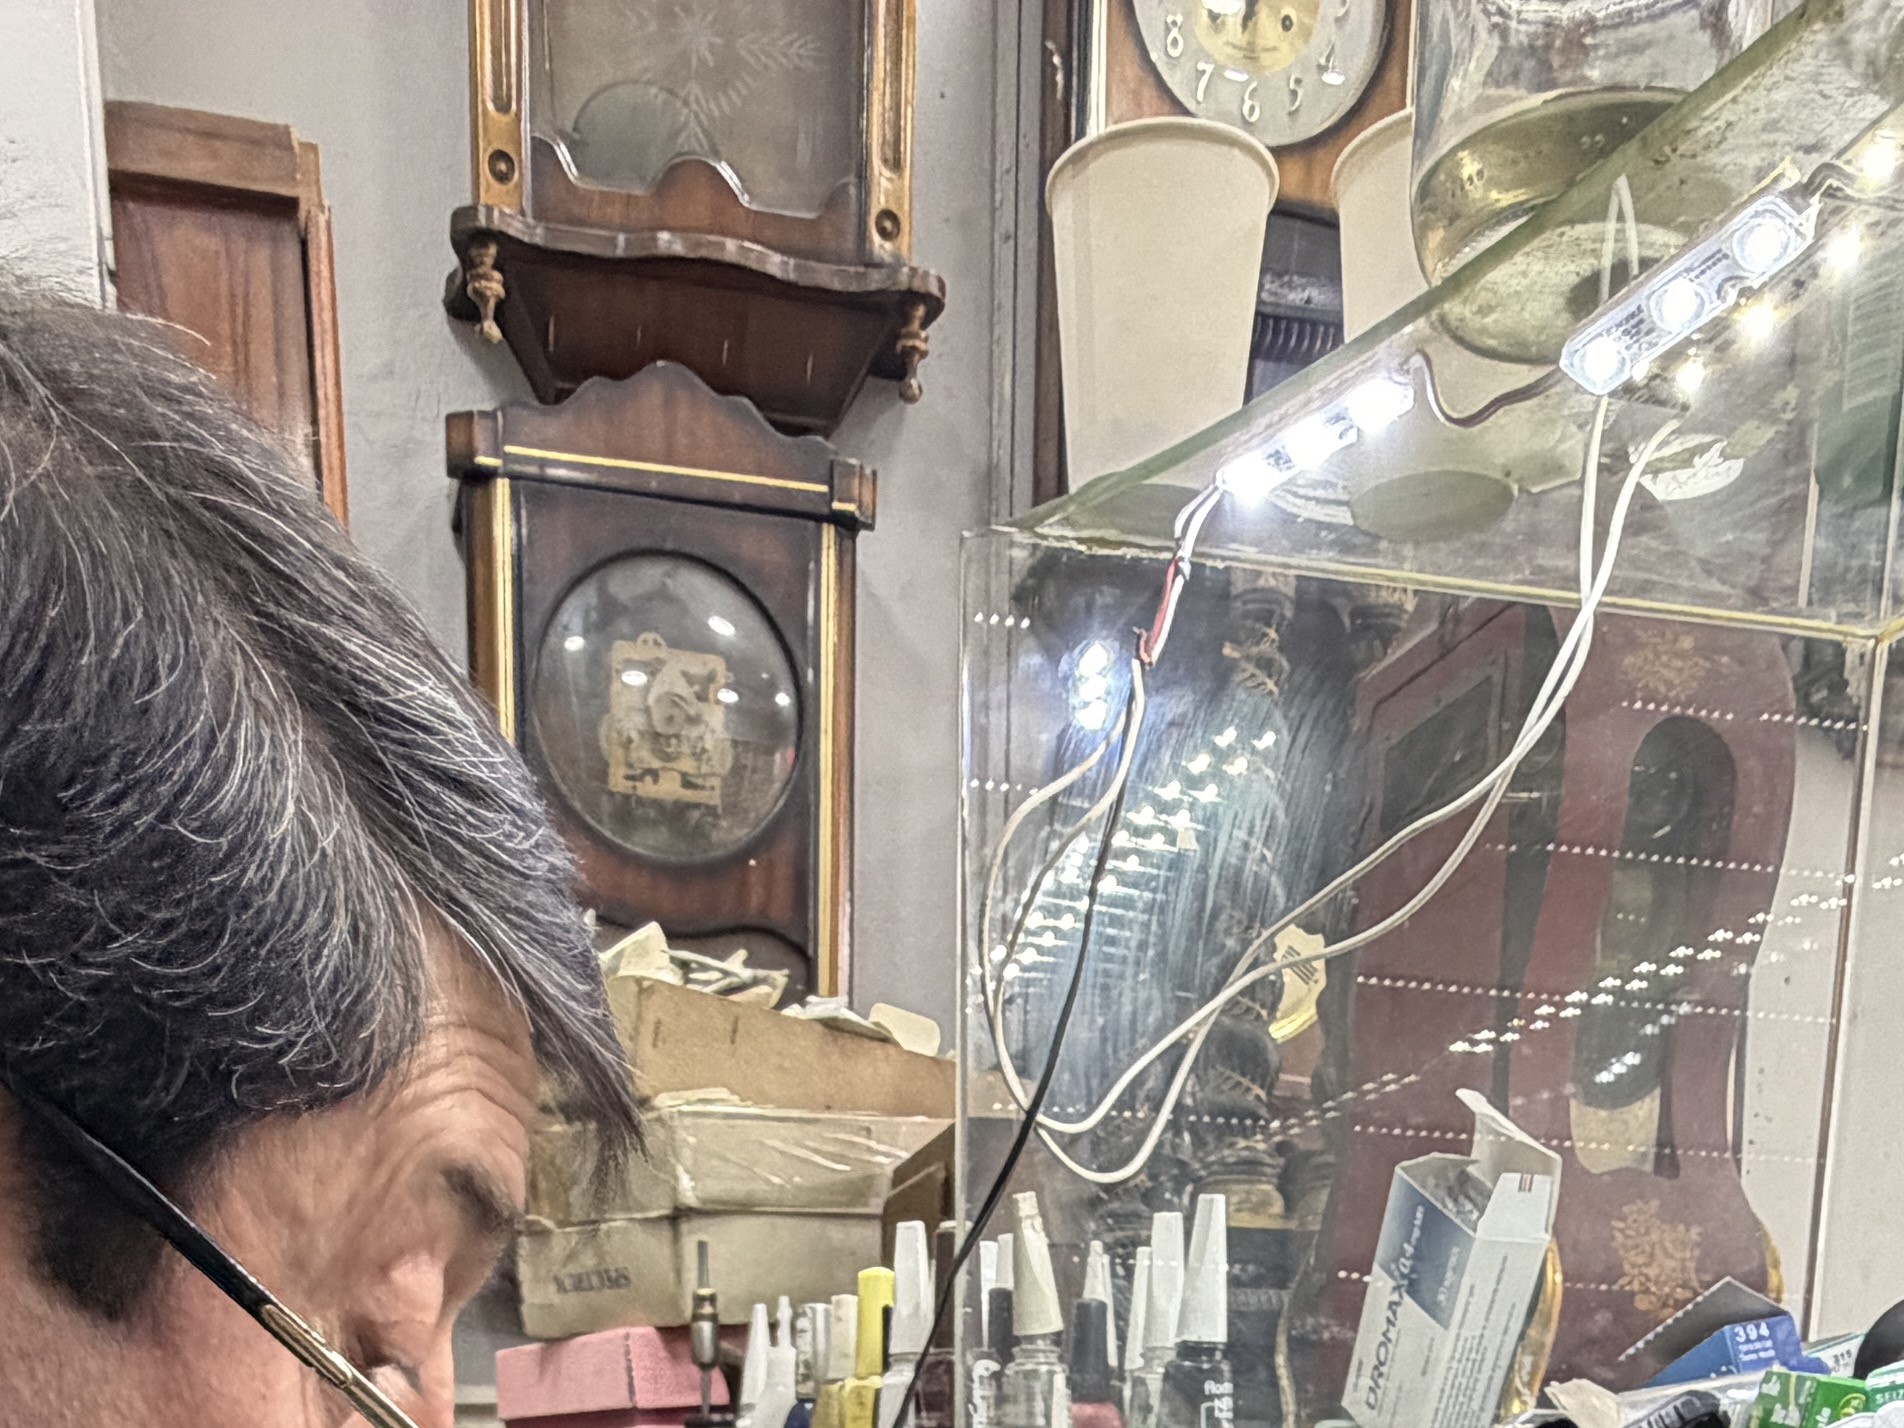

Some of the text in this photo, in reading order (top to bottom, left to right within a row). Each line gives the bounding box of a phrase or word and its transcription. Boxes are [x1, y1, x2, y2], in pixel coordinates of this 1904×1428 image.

[1166, 12, 1184, 58] 8
[1197, 60, 1215, 102] 7
[1242, 81, 1261, 123] 6
[1733, 1321, 1771, 1343] 394
